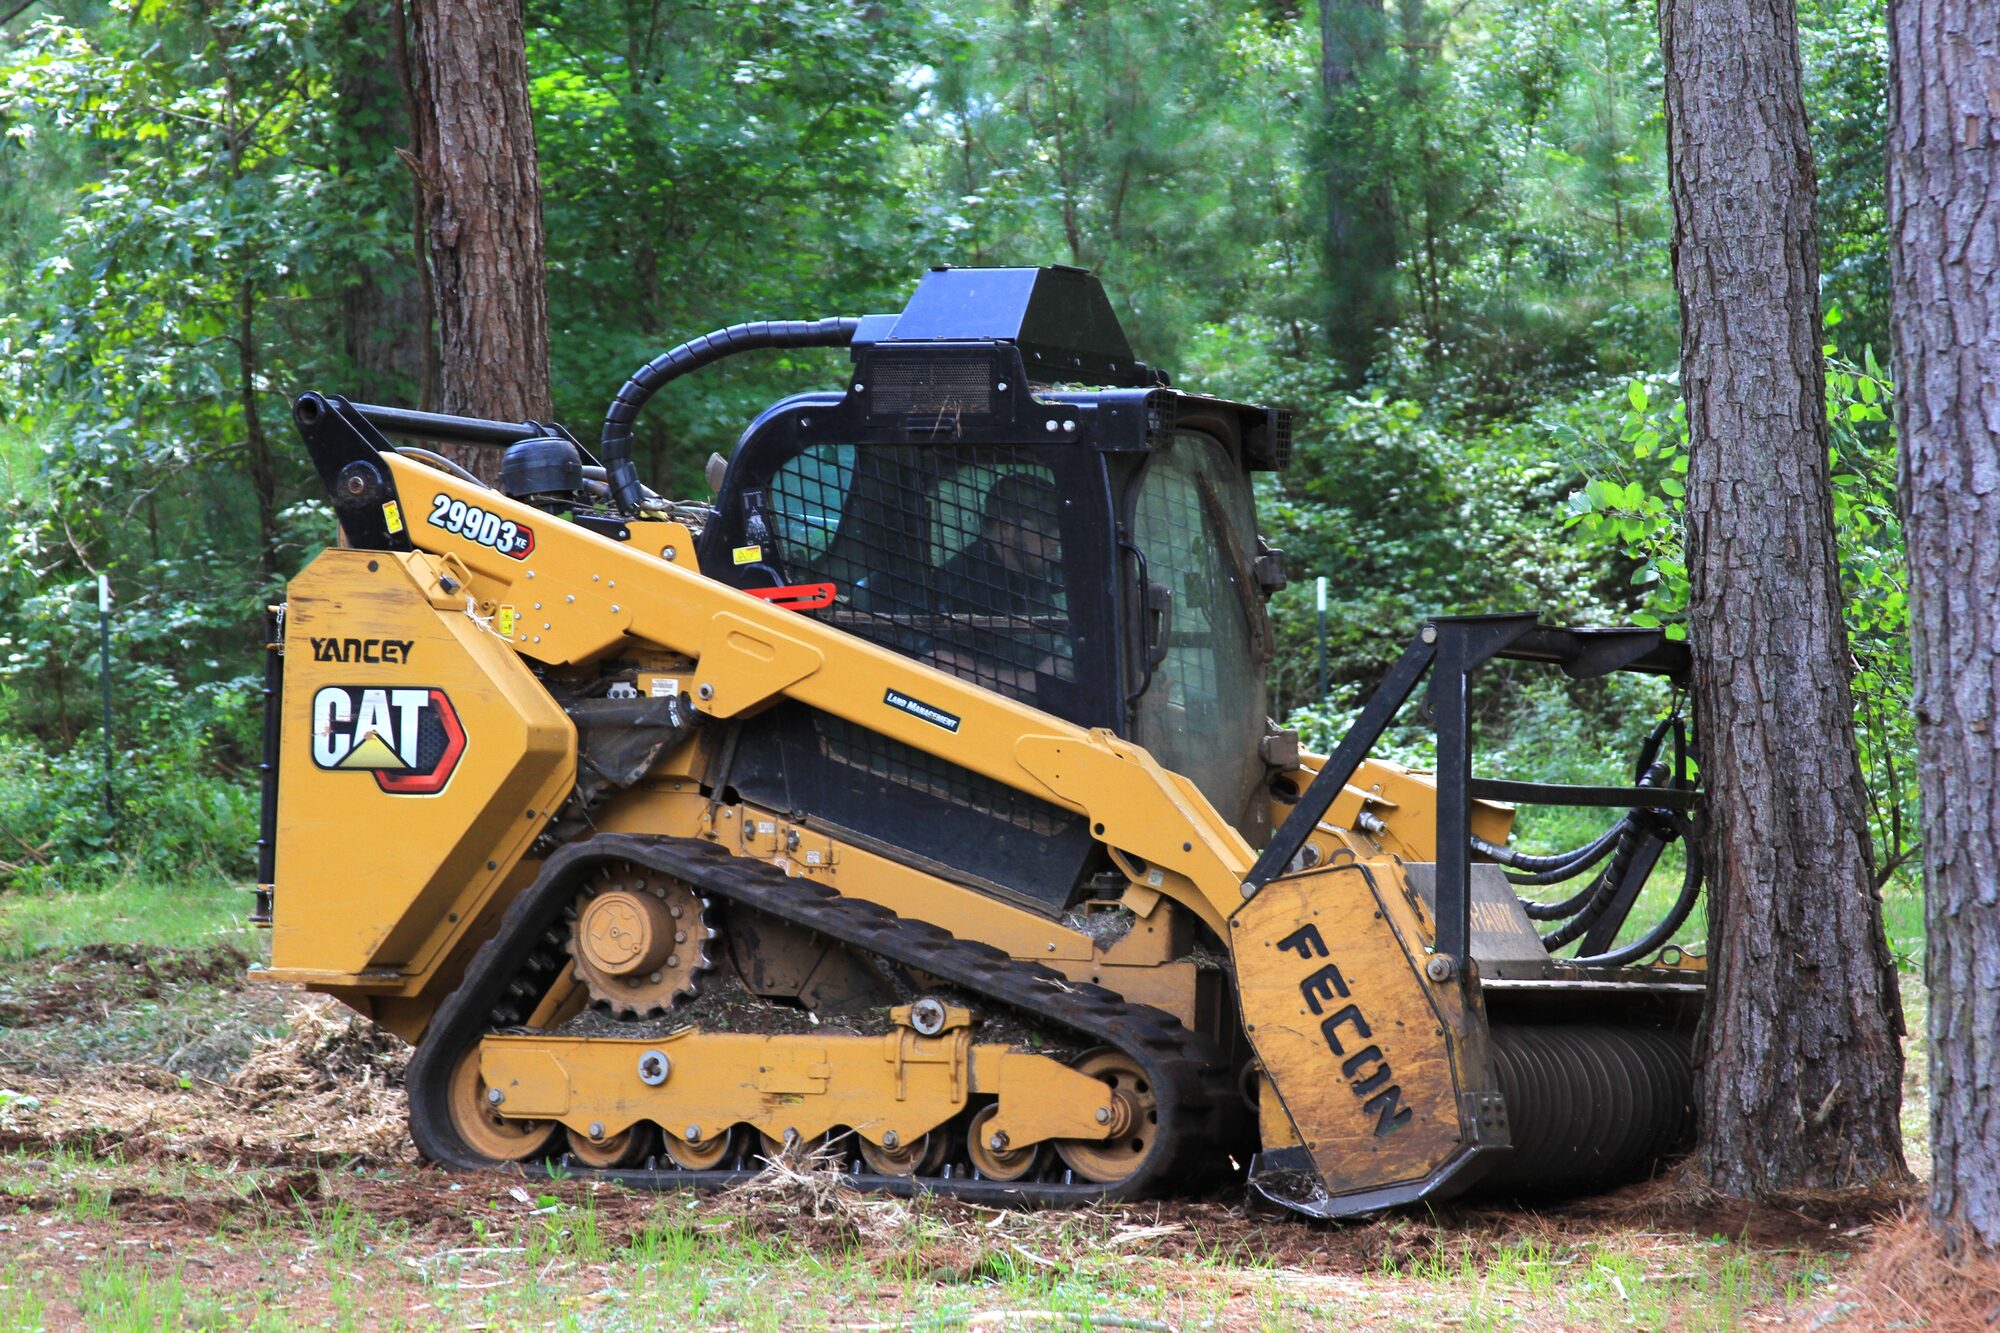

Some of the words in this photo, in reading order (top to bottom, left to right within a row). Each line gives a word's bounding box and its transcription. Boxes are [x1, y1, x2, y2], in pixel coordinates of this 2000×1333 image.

[428, 494, 517, 553] 299D3
[514, 536, 528, 549] XE
[310, 637, 415, 664] YANCEY
[313, 687, 429, 768] CAT
[886, 692, 908, 708] LAND
[906, 700, 958, 728] MANAGEMENT
[1276, 923, 1413, 1137] FECON
